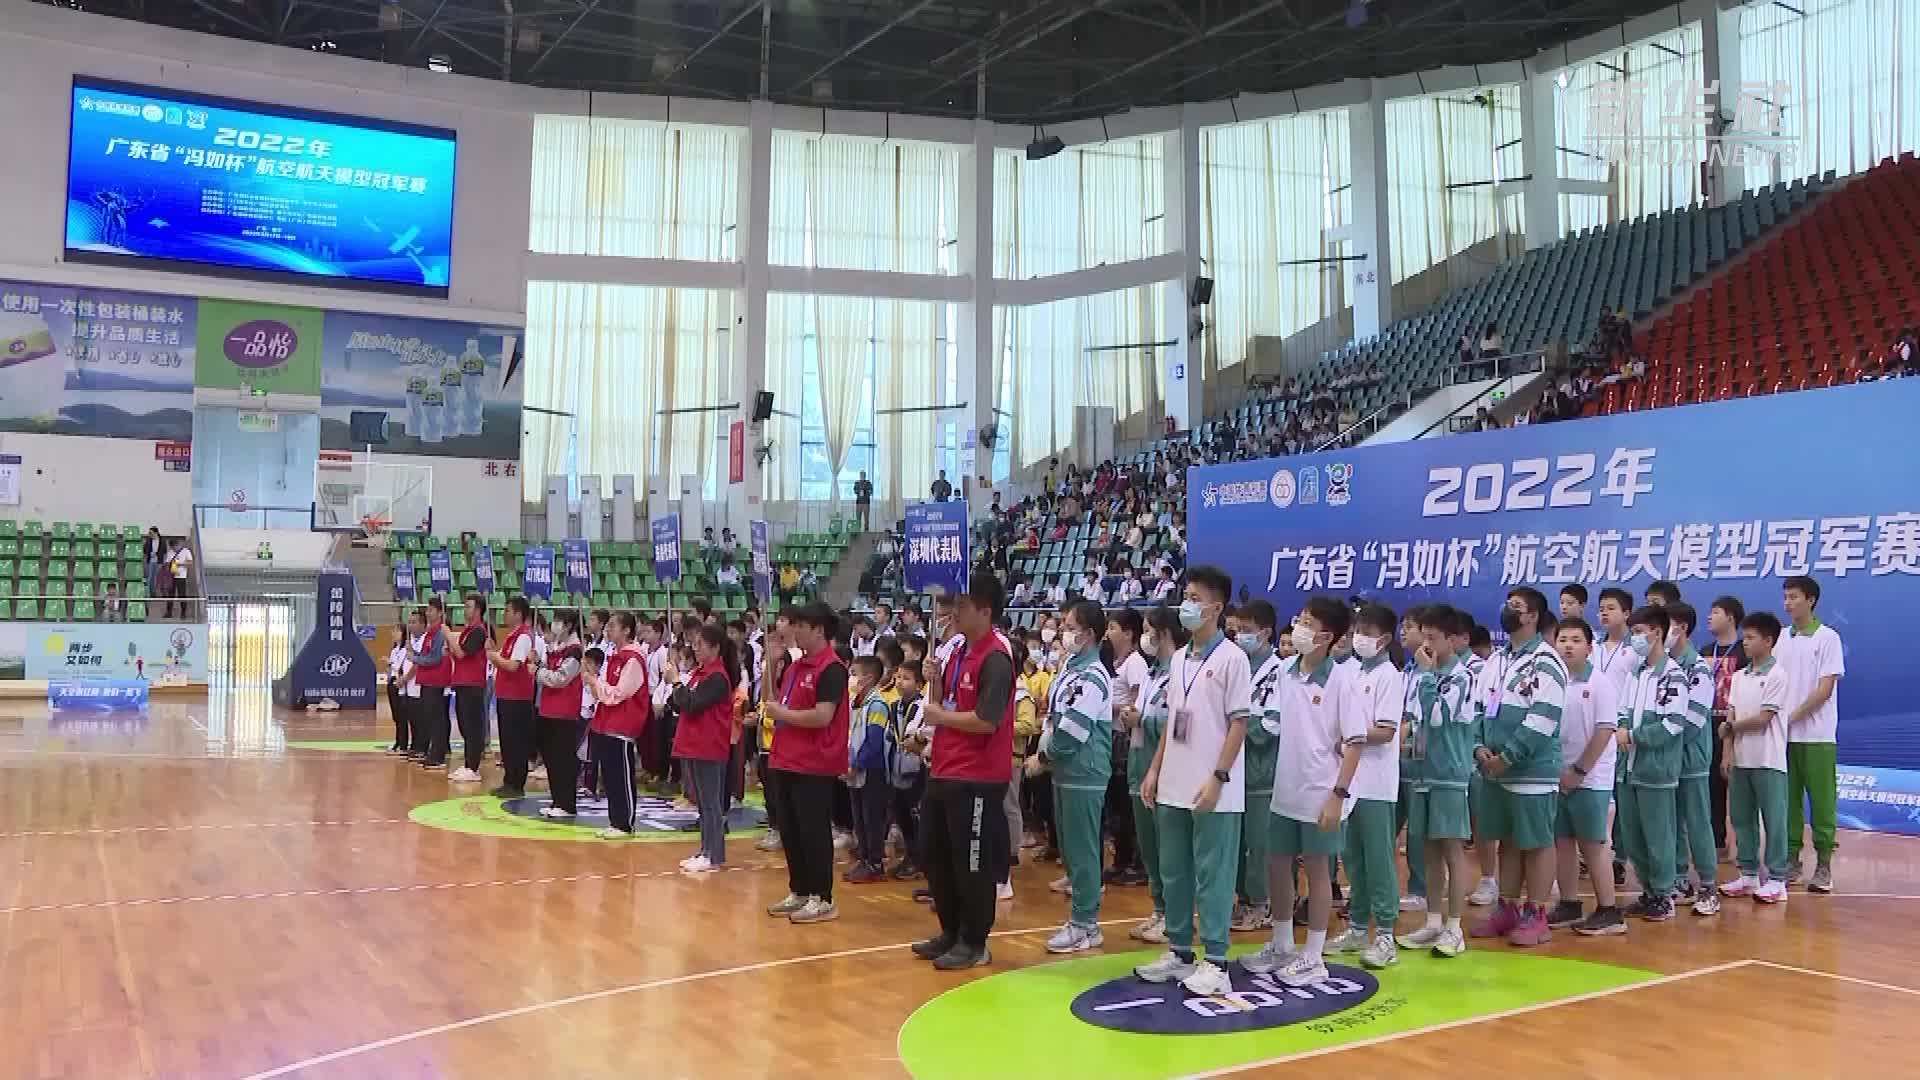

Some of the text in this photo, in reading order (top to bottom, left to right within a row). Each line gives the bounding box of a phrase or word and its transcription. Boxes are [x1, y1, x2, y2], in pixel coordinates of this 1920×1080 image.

[213, 126, 333, 159] 2022年
[1423, 447, 1657, 517] 2022年
[908, 535, 962, 564] 深圳代表队
[1266, 511, 1920, 592] 广东省“冯如杯”航空航天模型冠军赛
